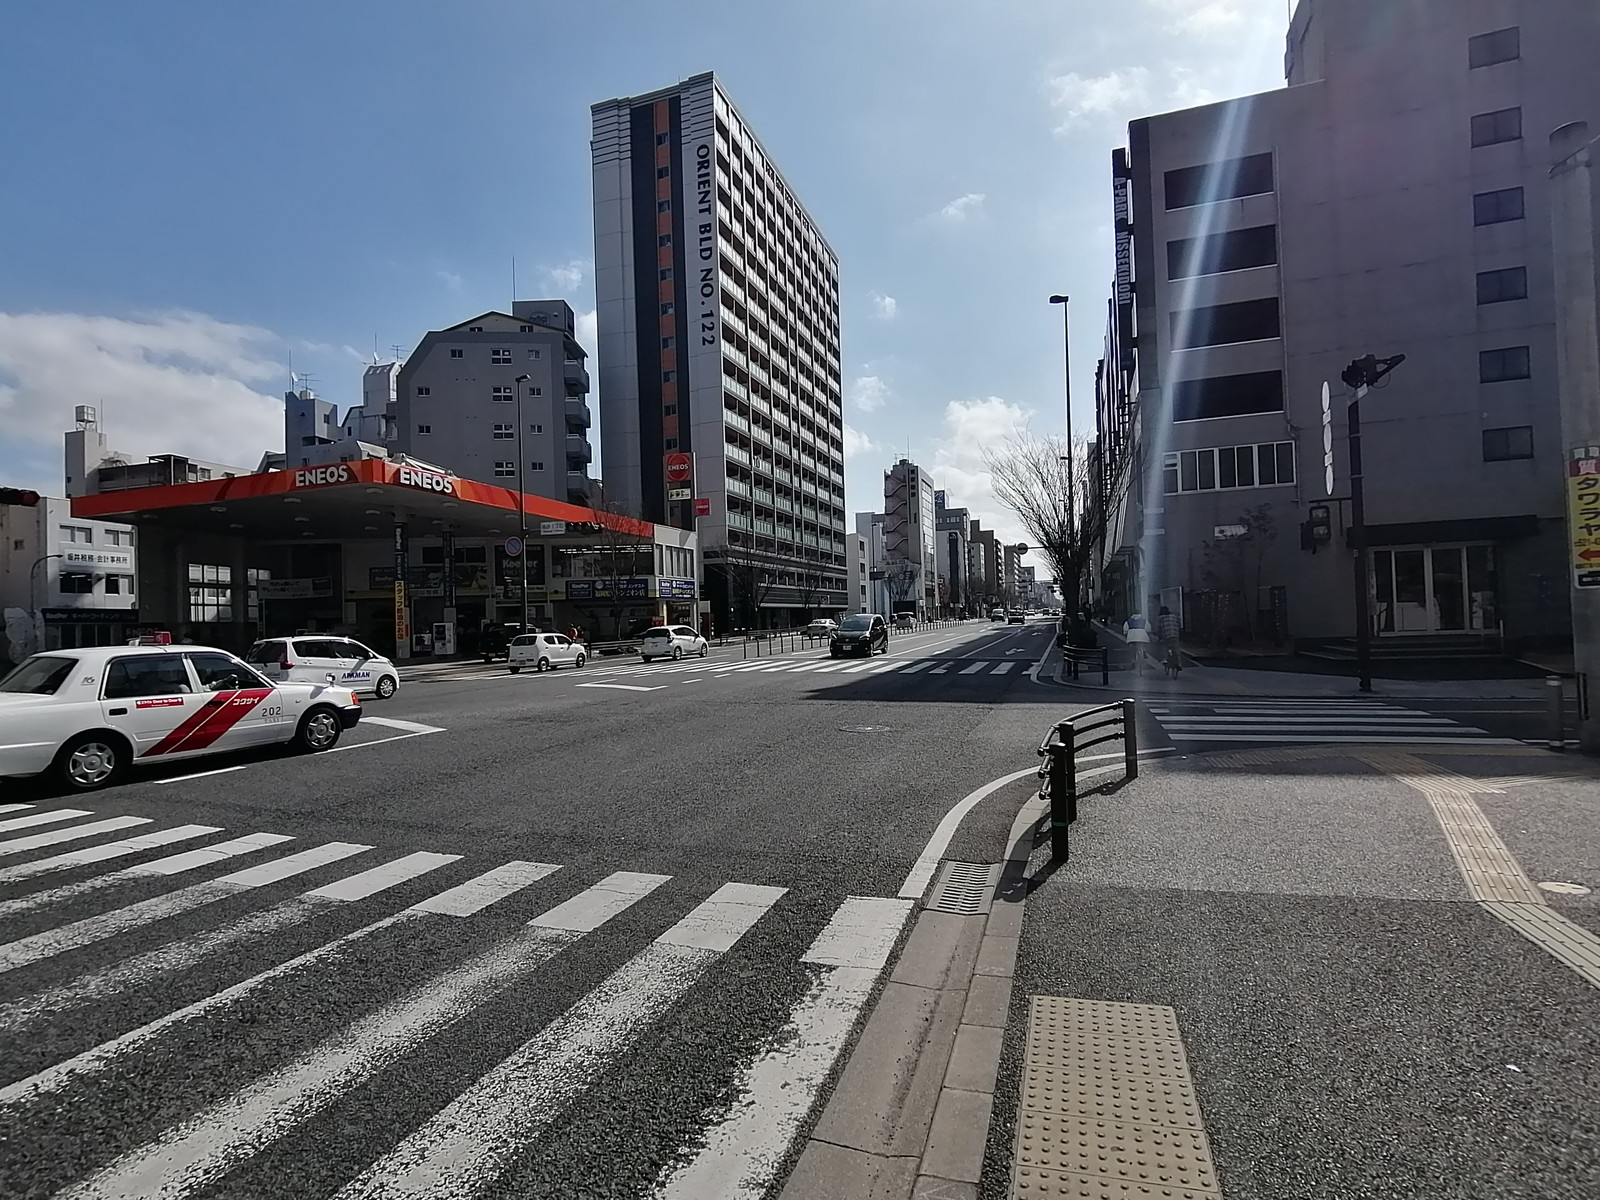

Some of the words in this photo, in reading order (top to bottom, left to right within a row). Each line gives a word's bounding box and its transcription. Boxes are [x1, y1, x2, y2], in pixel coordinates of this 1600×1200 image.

[696, 144, 712, 215] ORIENT
[1114, 177, 1128, 221] A-PARK
[699, 222, 713, 261] BLD
[1116, 231, 1131, 305] NISSEKIDORI
[295, 464, 348, 487] ENEOS
[668, 463, 689, 471] ENEOS
[400, 468, 453, 494] ENEOS
[502, 559, 538, 568] Keeer
[232, 696, 260, 706] コクサイ
[262, 706, 281, 717] 202
